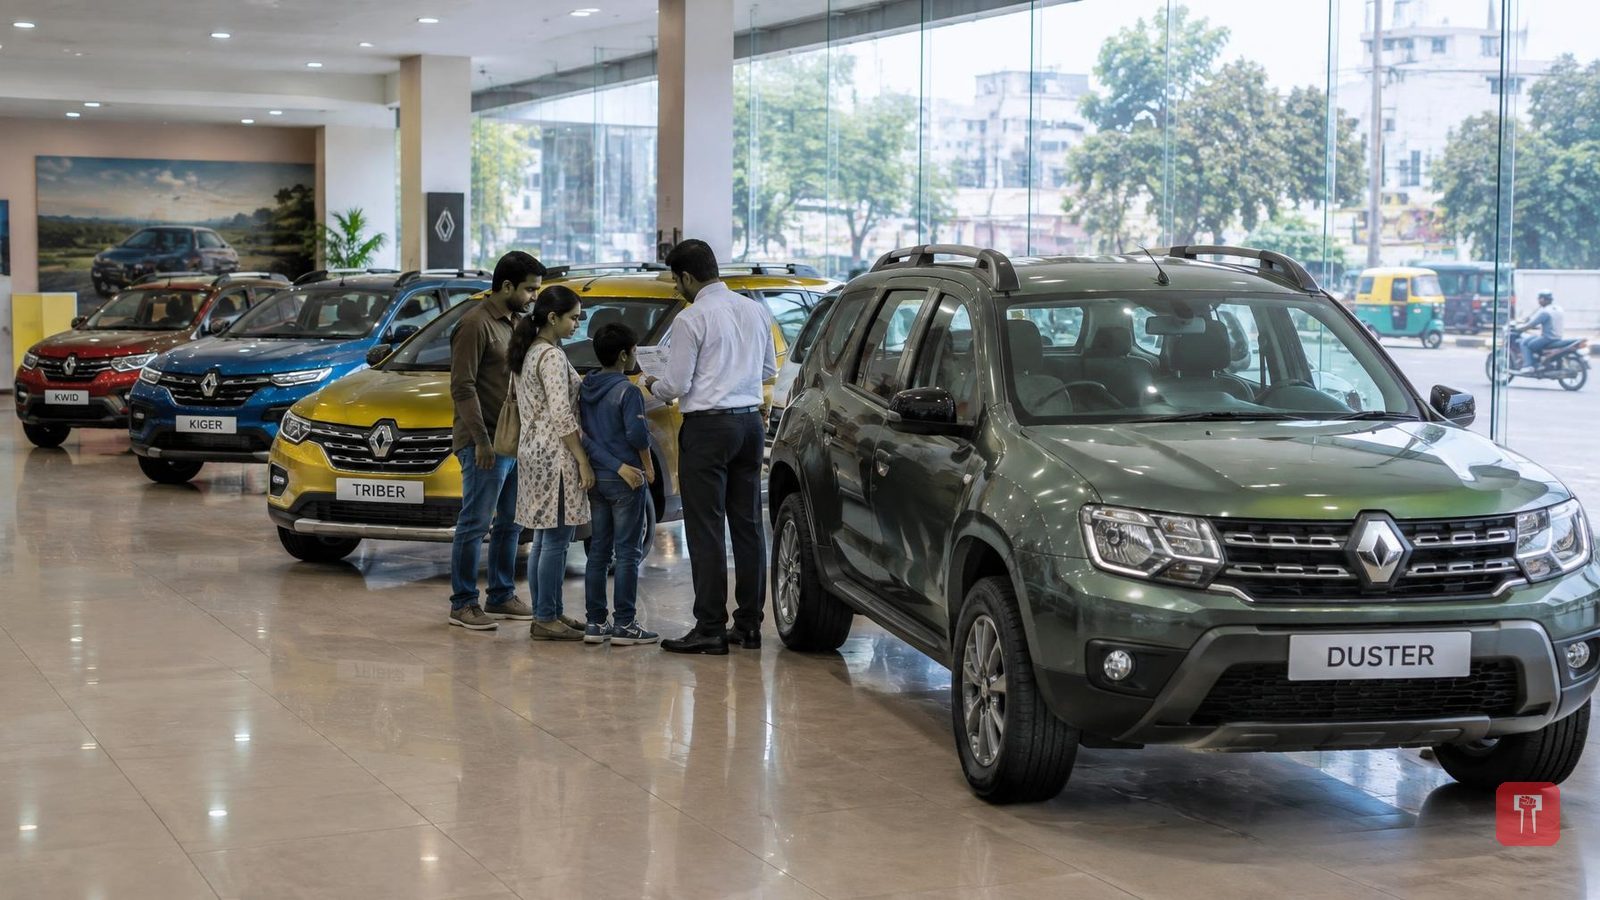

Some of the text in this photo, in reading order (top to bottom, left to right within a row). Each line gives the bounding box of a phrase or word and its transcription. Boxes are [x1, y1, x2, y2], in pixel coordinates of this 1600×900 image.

[54, 393, 79, 402] KWID
[189, 419, 223, 430] KIGER
[352, 483, 406, 499] TRIBER
[1327, 644, 1435, 668] DUSTER
